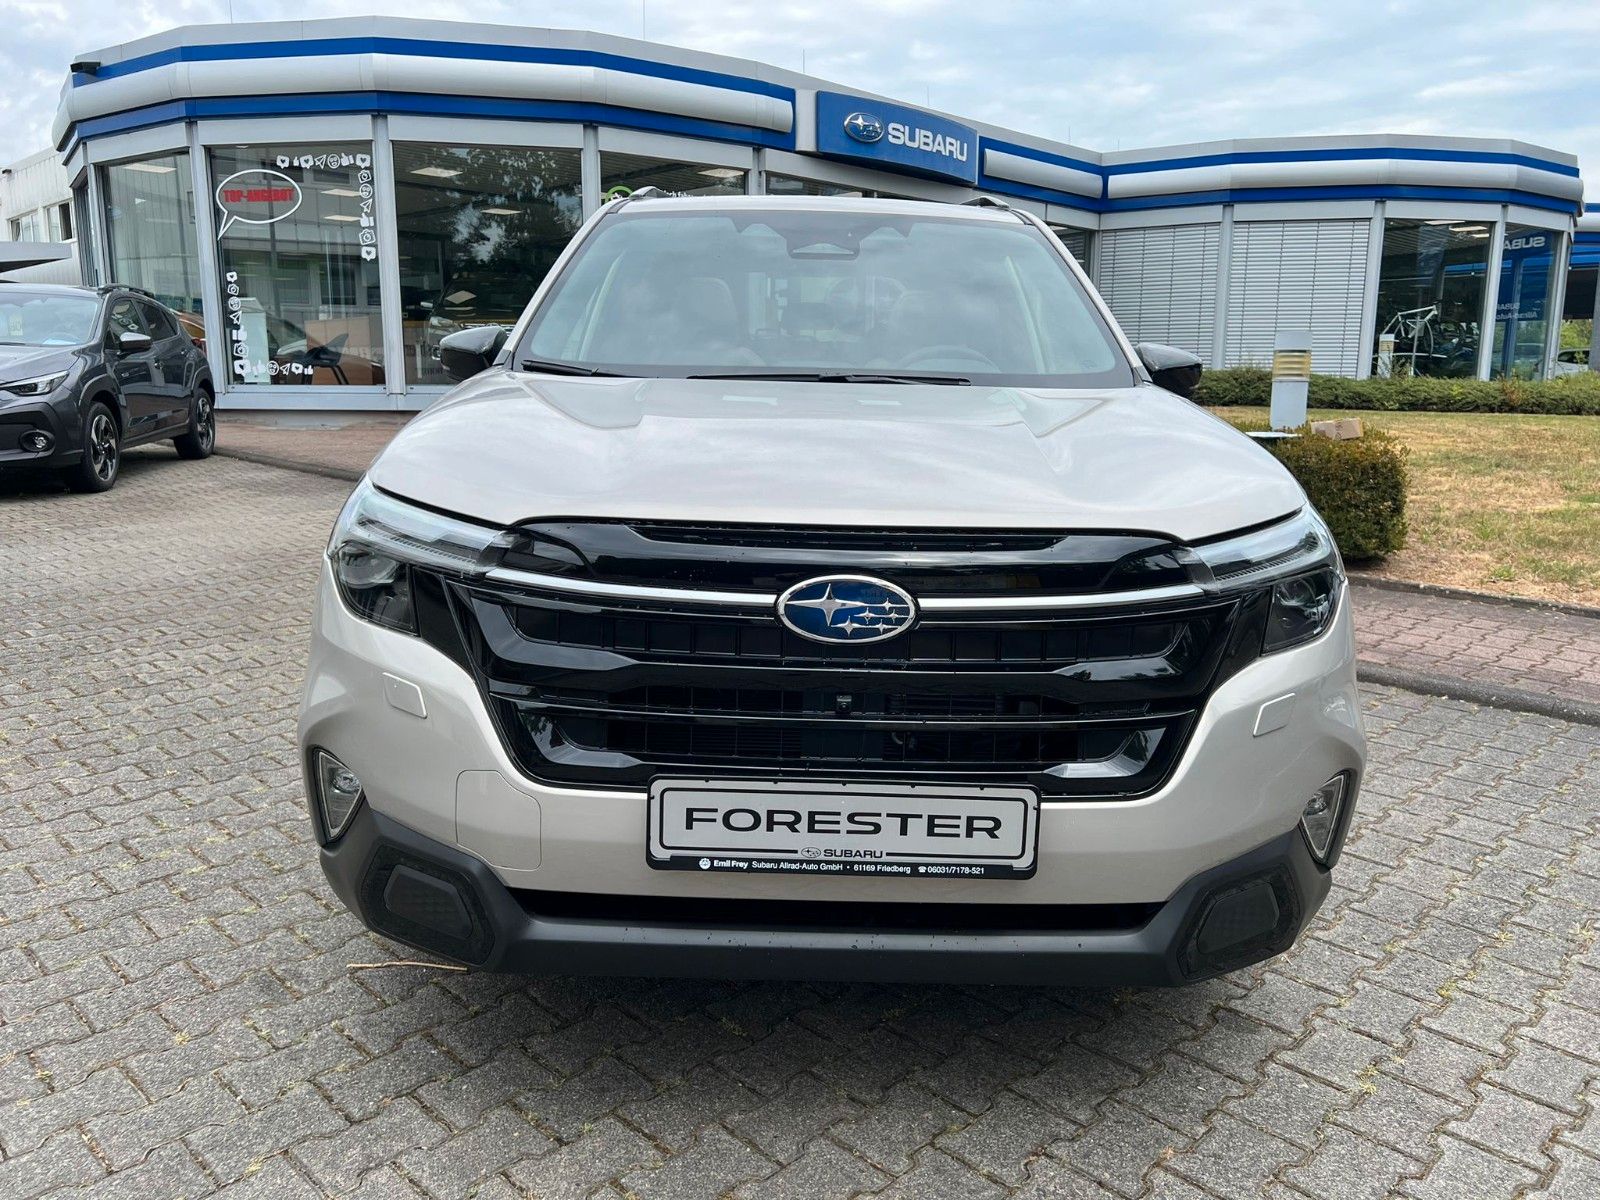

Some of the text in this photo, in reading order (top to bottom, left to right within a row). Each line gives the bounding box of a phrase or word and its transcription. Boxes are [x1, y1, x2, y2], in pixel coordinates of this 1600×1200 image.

[887, 122, 968, 162] SUBARU
[685, 807, 1003, 840] FORESTER
[823, 848, 884, 859] SUBARU
[713, 859, 985, 875] Emil Frey Subaru Allrad-Auto GmbH 61169 Friedberg 06031/7178-521
